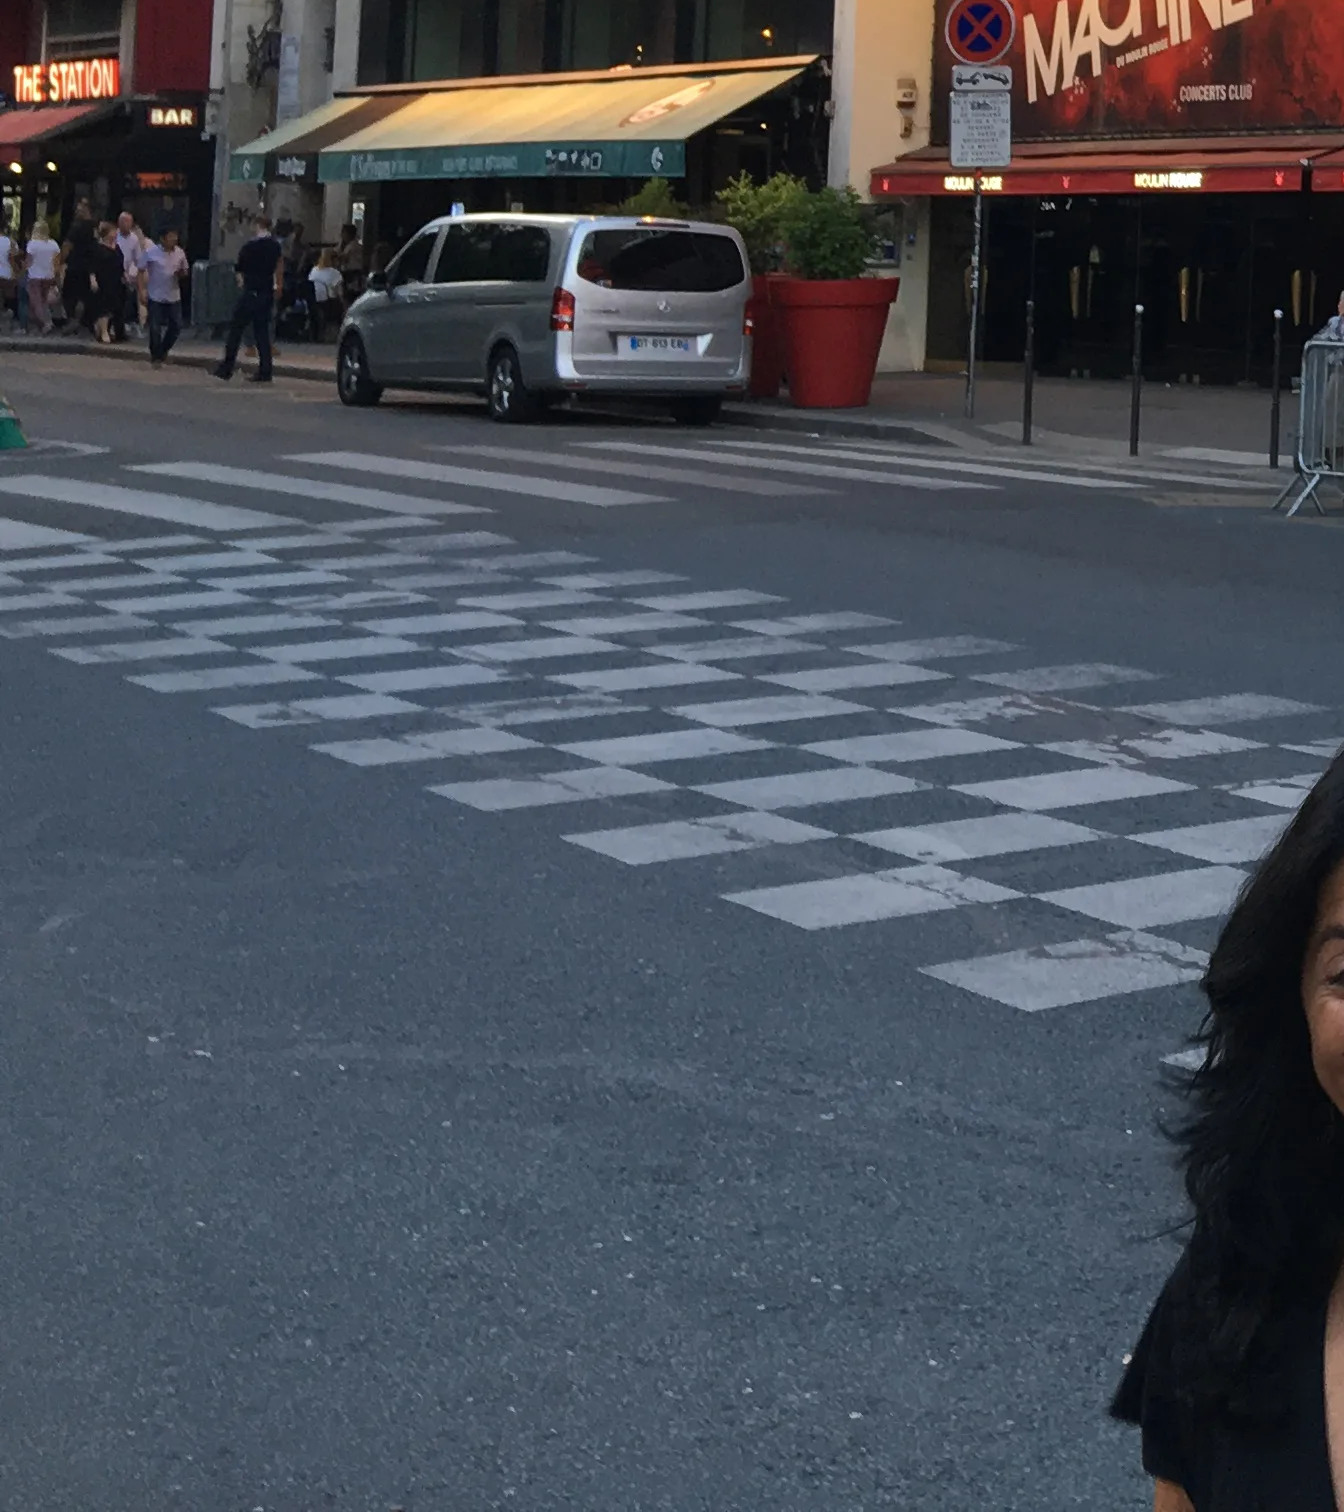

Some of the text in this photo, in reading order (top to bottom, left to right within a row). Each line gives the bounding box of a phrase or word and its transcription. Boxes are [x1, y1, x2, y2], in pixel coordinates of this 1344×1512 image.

[1125, 45, 1148, 65] MOULIN
[1148, 36, 1168, 55] ROUGE
[13, 59, 115, 103] THE STATION
[1180, 83, 1253, 103] CONCERTS CLUB
[151, 107, 194, 126] BAR
[944, 175, 1003, 191] MOULIN OUGE
[1134, 171, 1202, 189] MOULIN ROUGE
